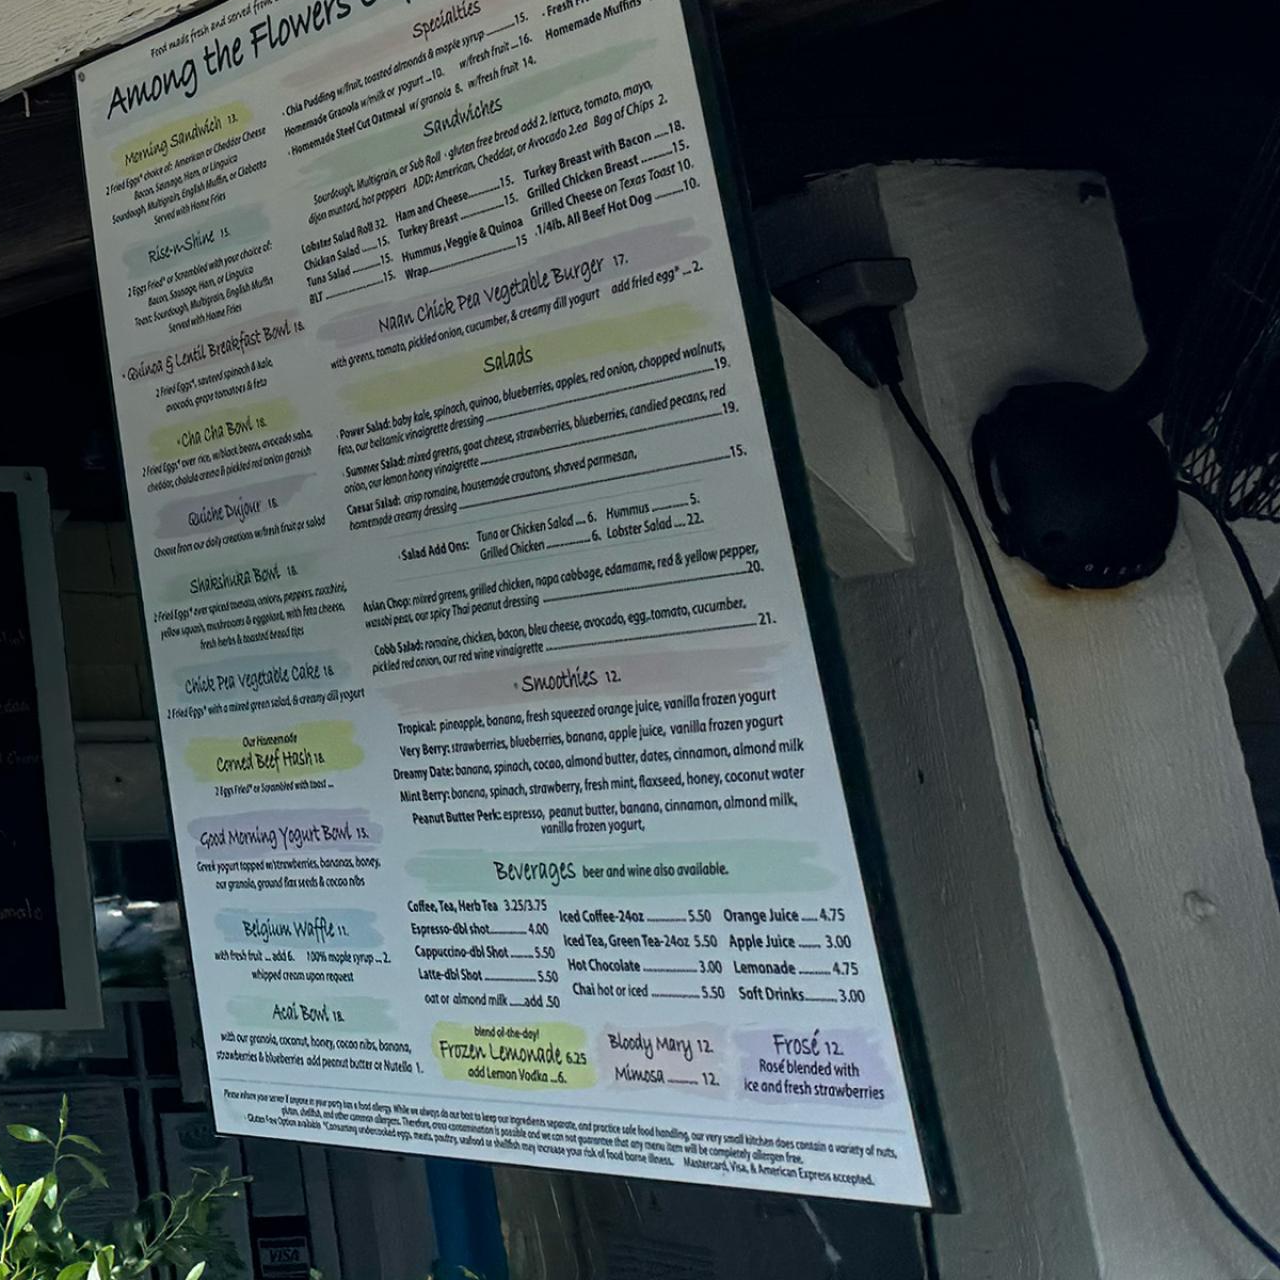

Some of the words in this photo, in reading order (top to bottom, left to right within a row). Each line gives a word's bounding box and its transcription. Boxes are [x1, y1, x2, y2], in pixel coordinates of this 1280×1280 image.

[412, 0, 482, 40] Specialties
[544, 11, 602, 41] Homemade
[106, 58, 198, 120] Among
[202, 36, 245, 76] the
[422, 97, 503, 138] Sandwiches
[522, 162, 557, 181] Turkey
[558, 150, 593, 170] Breast
[592, 141, 617, 159] with
[617, 132, 652, 150] Bacon
[668, 119, 686, 134] 18.
[526, 177, 561, 199] Grilled
[561, 167, 604, 188] Chicken
[603, 154, 640, 175] Breast
[671, 138, 690, 154] 15.
[530, 196, 565, 218] Grilled
[564, 187, 603, 207] Cheese
[603, 182, 618, 195] on
[618, 173, 647, 191] Texas
[647, 163, 676, 181] Toast
[677, 157, 694, 173] 10.
[378, 313, 415, 333] Naan
[416, 297, 457, 323] Chick
[456, 291, 481, 311] Pea
[482, 270, 551, 306] Vegetable
[549, 257, 605, 284] Burger
[612, 253, 629, 267] 17.
[483, 345, 534, 373] Salads
[521, 665, 599, 693] Smoothies
[605, 669, 622, 683] 12.
[492, 861, 577, 883] Beverages
[582, 864, 605, 879] beer
[605, 863, 626, 878] and
[626, 863, 652, 877] wine
[653, 862, 676, 877] also
[676, 861, 729, 876] available.
[241, 918, 292, 944] Belgium
[292, 916, 335, 944] Waffle
[337, 925, 349, 936] 11.
[723, 908, 767, 926] Orange
[769, 907, 800, 923] Juice
[819, 907, 846, 922] 4.75
[729, 933, 764, 952] Apple
[765, 934, 796, 949] Juice
[825, 934, 852, 949] 3.00
[733, 960, 797, 976] Lemonade
[832, 961, 859, 976] 4.75
[738, 985, 764, 1001] Soft
[764, 986, 805, 1002] Drinks
[838, 988, 866, 1004] 3.00
[439, 1039, 487, 1060] Frozen
[488, 1040, 563, 1066] Lemonade
[565, 1051, 587, 1066] 6.25
[607, 1032, 654, 1061] Bloody
[655, 1036, 694, 1062] Mary
[696, 1039, 714, 1054] 12.
[772, 1028, 821, 1057] Frosé
[824, 1041, 844, 1056] 12.
[614, 1063, 666, 1084] Mimosa
[701, 1071, 720, 1087] 12.
[758, 1058, 785, 1074] Rosé
[782, 1058, 832, 1077] blended
[833, 1062, 860, 1078] with
[744, 1077, 760, 1092] ice
[760, 1079, 783, 1094] and
[783, 1078, 813, 1096] fresh
[813, 1082, 885, 1101] strawberries
[269, 1248, 300, 1263] VISA
